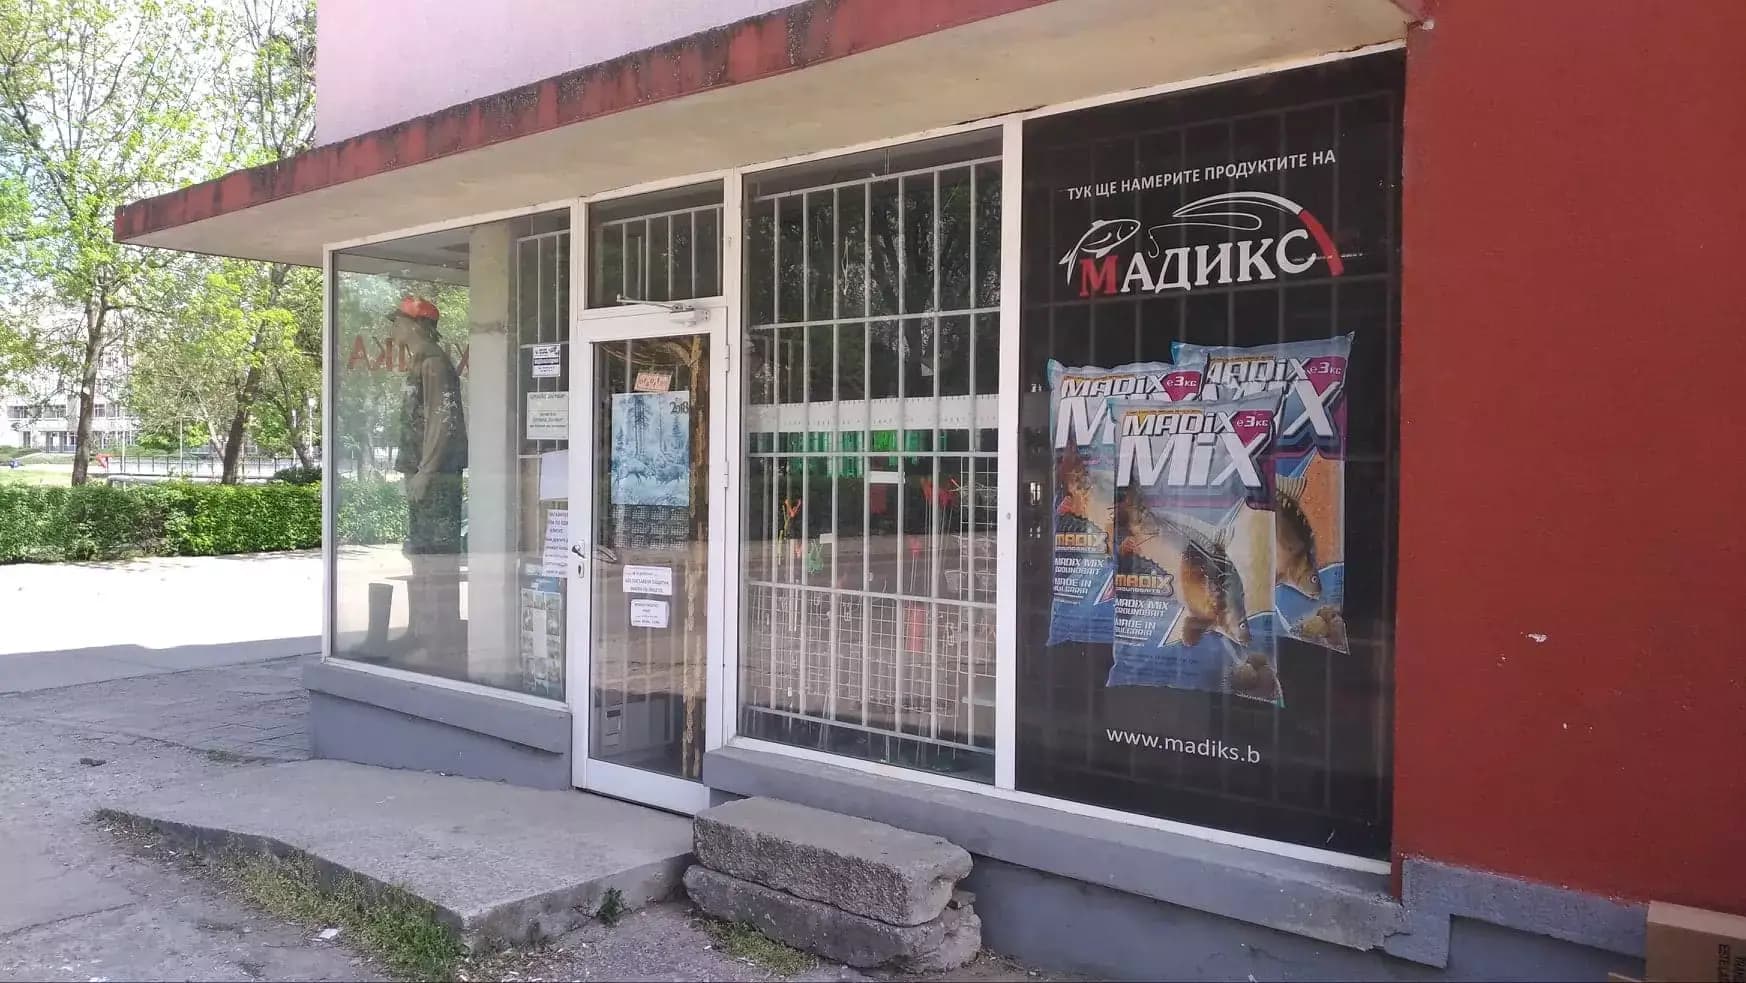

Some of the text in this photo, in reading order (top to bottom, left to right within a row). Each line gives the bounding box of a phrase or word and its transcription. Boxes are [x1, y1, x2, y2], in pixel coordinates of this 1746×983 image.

[1068, 149, 1336, 200] ТУК ЩЕ НАМЕРИТЕ ПРОДУКТИТЕ НА
[1079, 229, 1318, 297] МАДИКС
[1080, 578, 1092, 588] IN
[1144, 620, 1156, 630] IN
[1106, 728, 1261, 764] www.madiks.b
